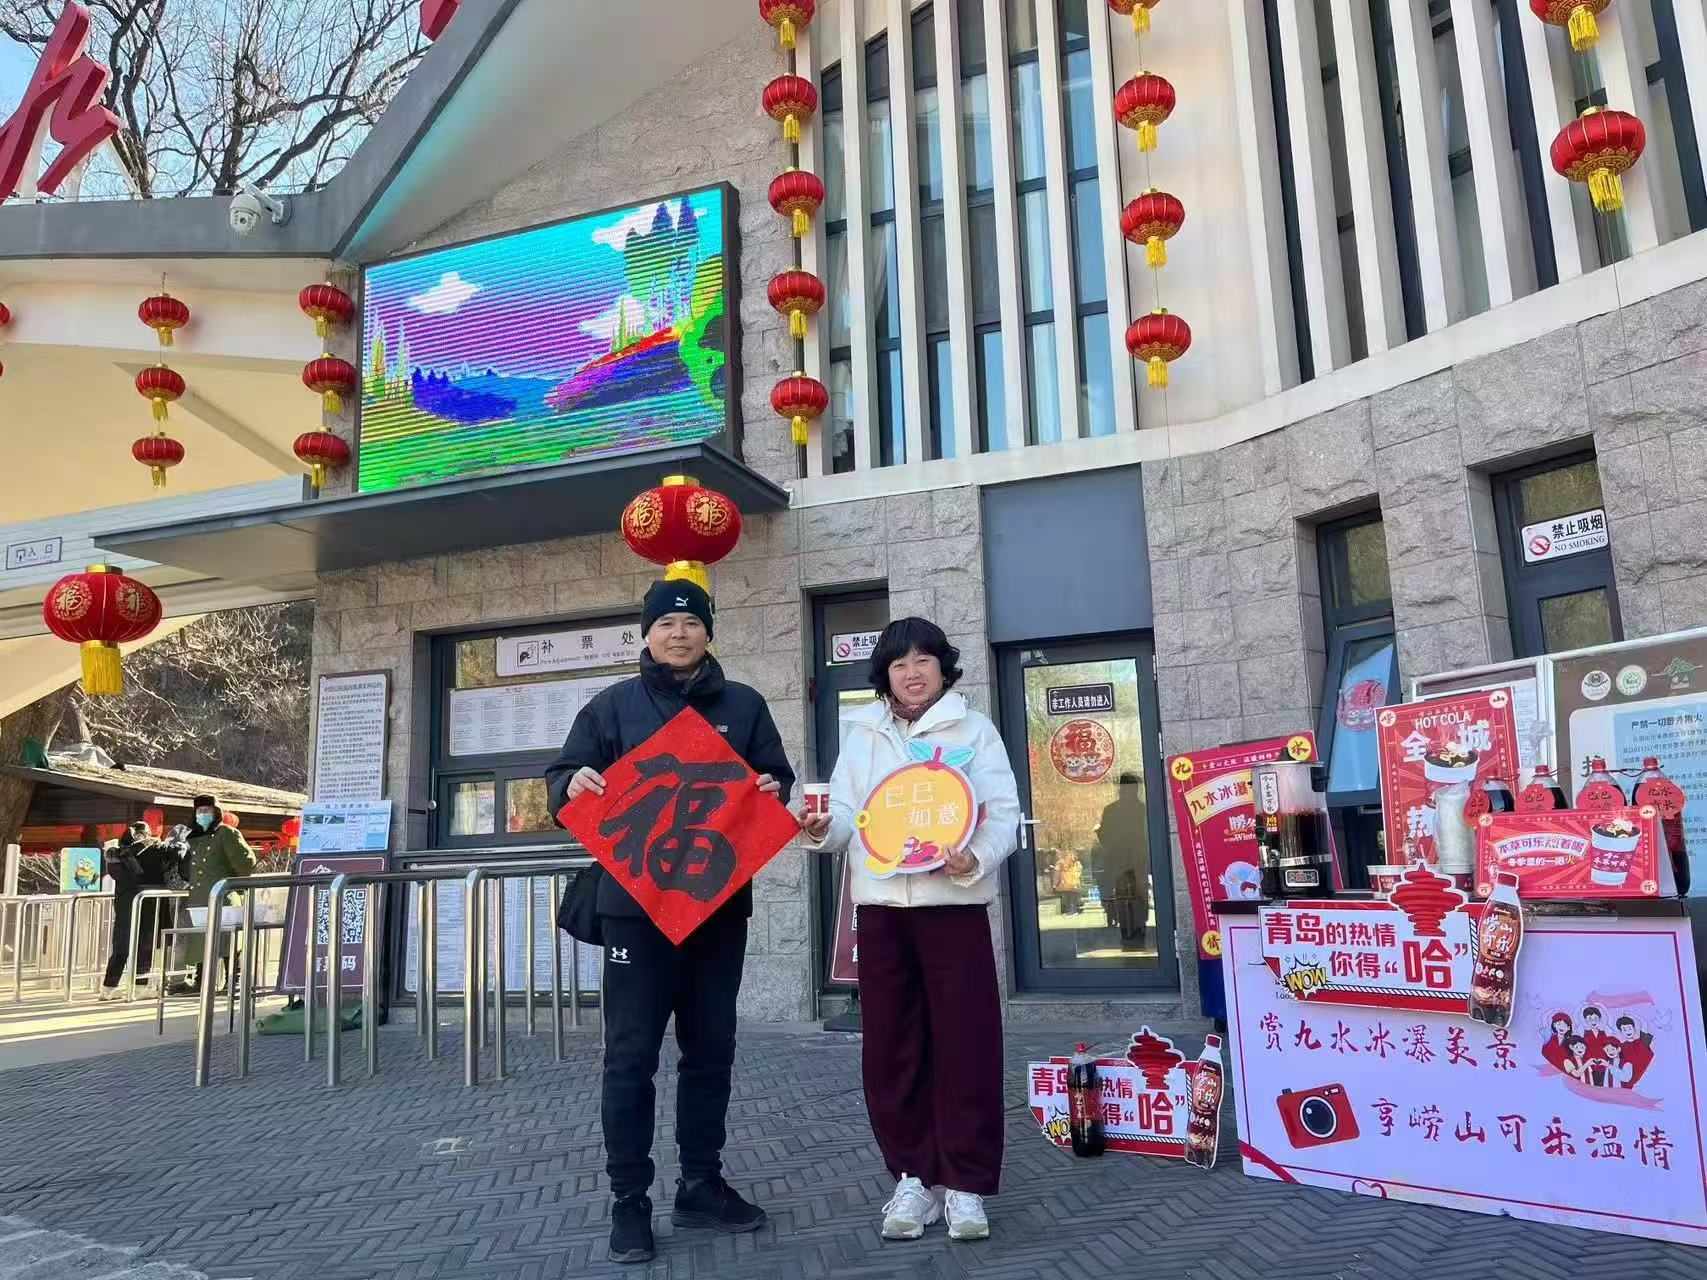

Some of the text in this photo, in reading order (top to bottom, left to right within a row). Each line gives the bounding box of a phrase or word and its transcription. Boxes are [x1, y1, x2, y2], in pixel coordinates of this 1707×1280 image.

[696, 497, 727, 530] 福
[1552, 514, 1604, 539] 禁止吸烟
[27, 543, 53, 557] 入口
[1554, 535, 1605, 552] NO SMOKING
[541, 630, 634, 655] 补票处
[852, 635, 878, 647] 禁止吸
[1051, 694, 1111, 710] 非工作人员请勿进入
[1415, 710, 1472, 730] HOT COLA
[1064, 723, 1097, 753] 福
[1291, 741, 1309, 755] 水
[1175, 761, 1191, 775] 九
[905, 801, 959, 829] 如意
[598, 752, 749, 902] 福
[1499, 837, 1585, 855] 本草可乐热着喝
[1508, 855, 1575, 867] 冬季里的一把火
[1265, 912, 1397, 948] 青岛的热情
[1284, 967, 1327, 993] WOW
[1259, 1012, 1517, 1071] 赏九水冰瀑美景
[1047, 1119, 1070, 1138] WO
[1370, 1097, 1674, 1171] 享崂山可乐温情
